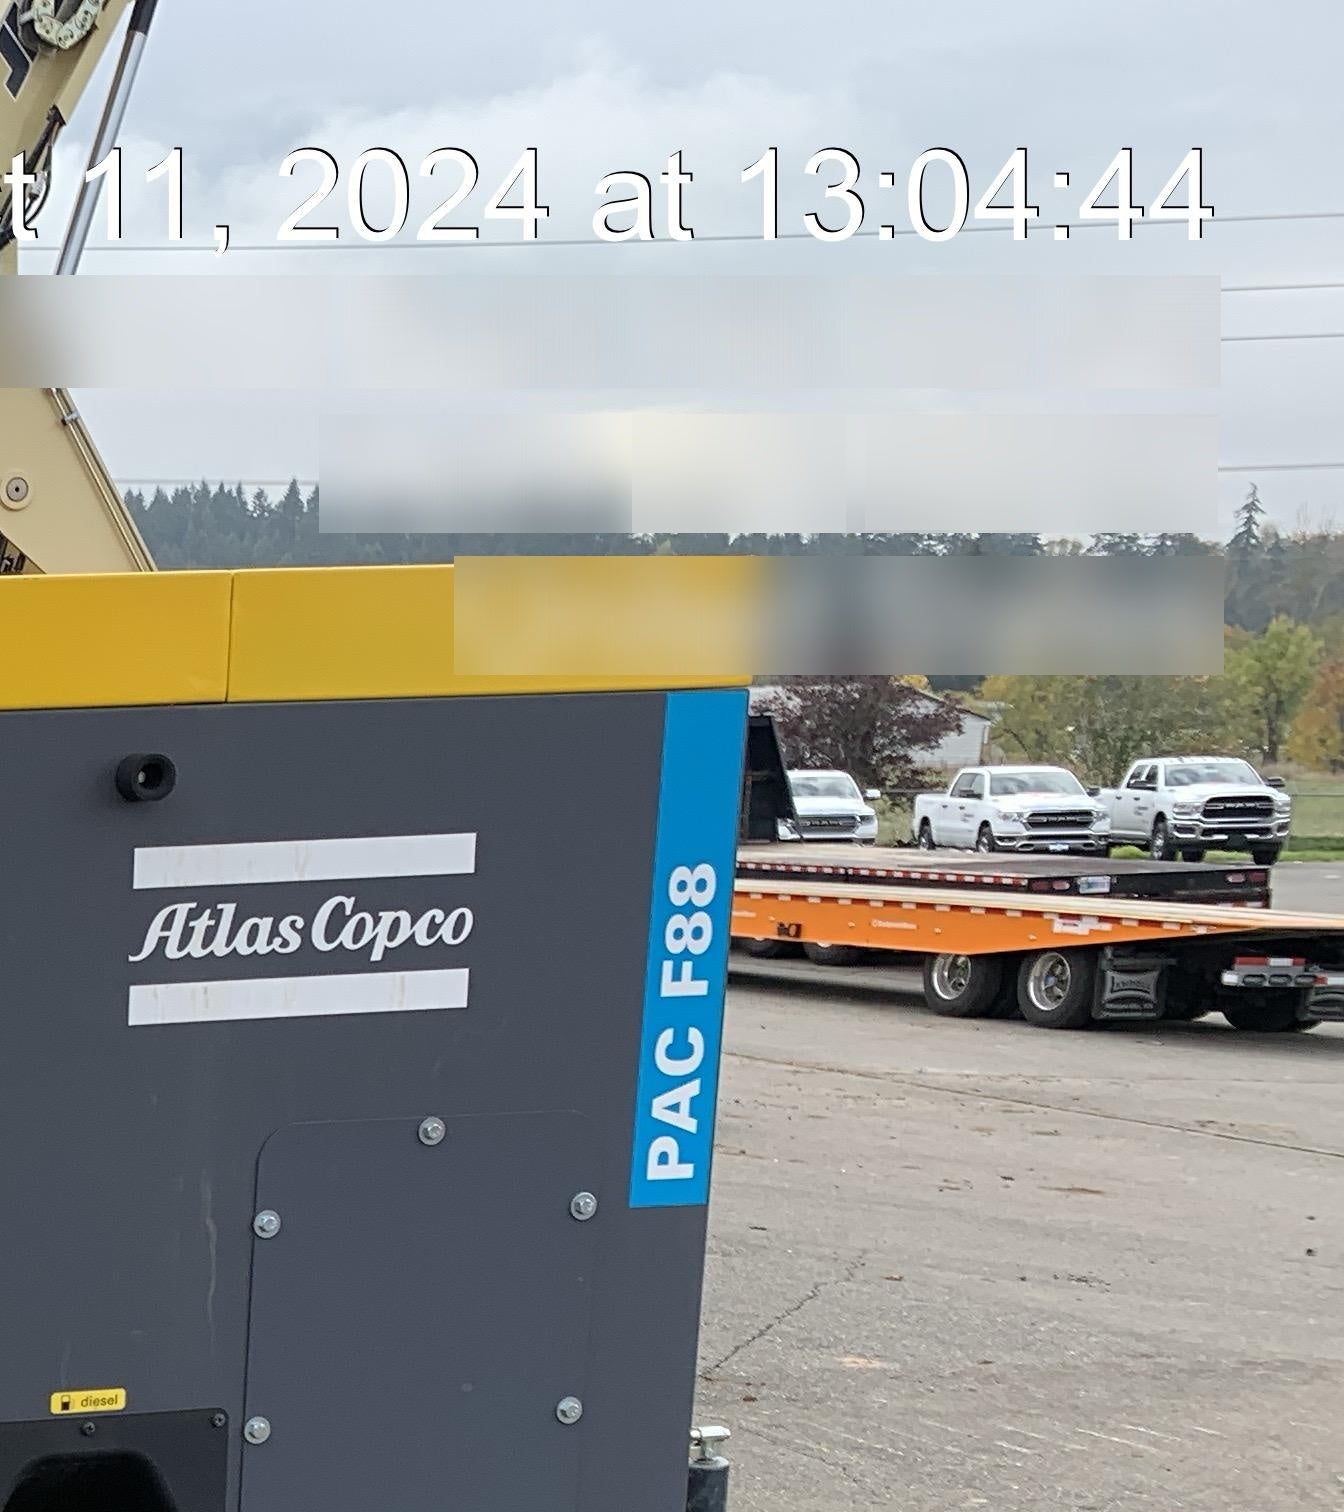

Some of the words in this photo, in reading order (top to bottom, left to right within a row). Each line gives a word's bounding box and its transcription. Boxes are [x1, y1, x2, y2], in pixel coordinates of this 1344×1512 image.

[128, 902, 304, 962] Atlas
[311, 894, 473, 961] Copco
[661, 862, 717, 998] F88
[646, 1026, 706, 1181] PAC
[81, 1395, 118, 1408] diesel
